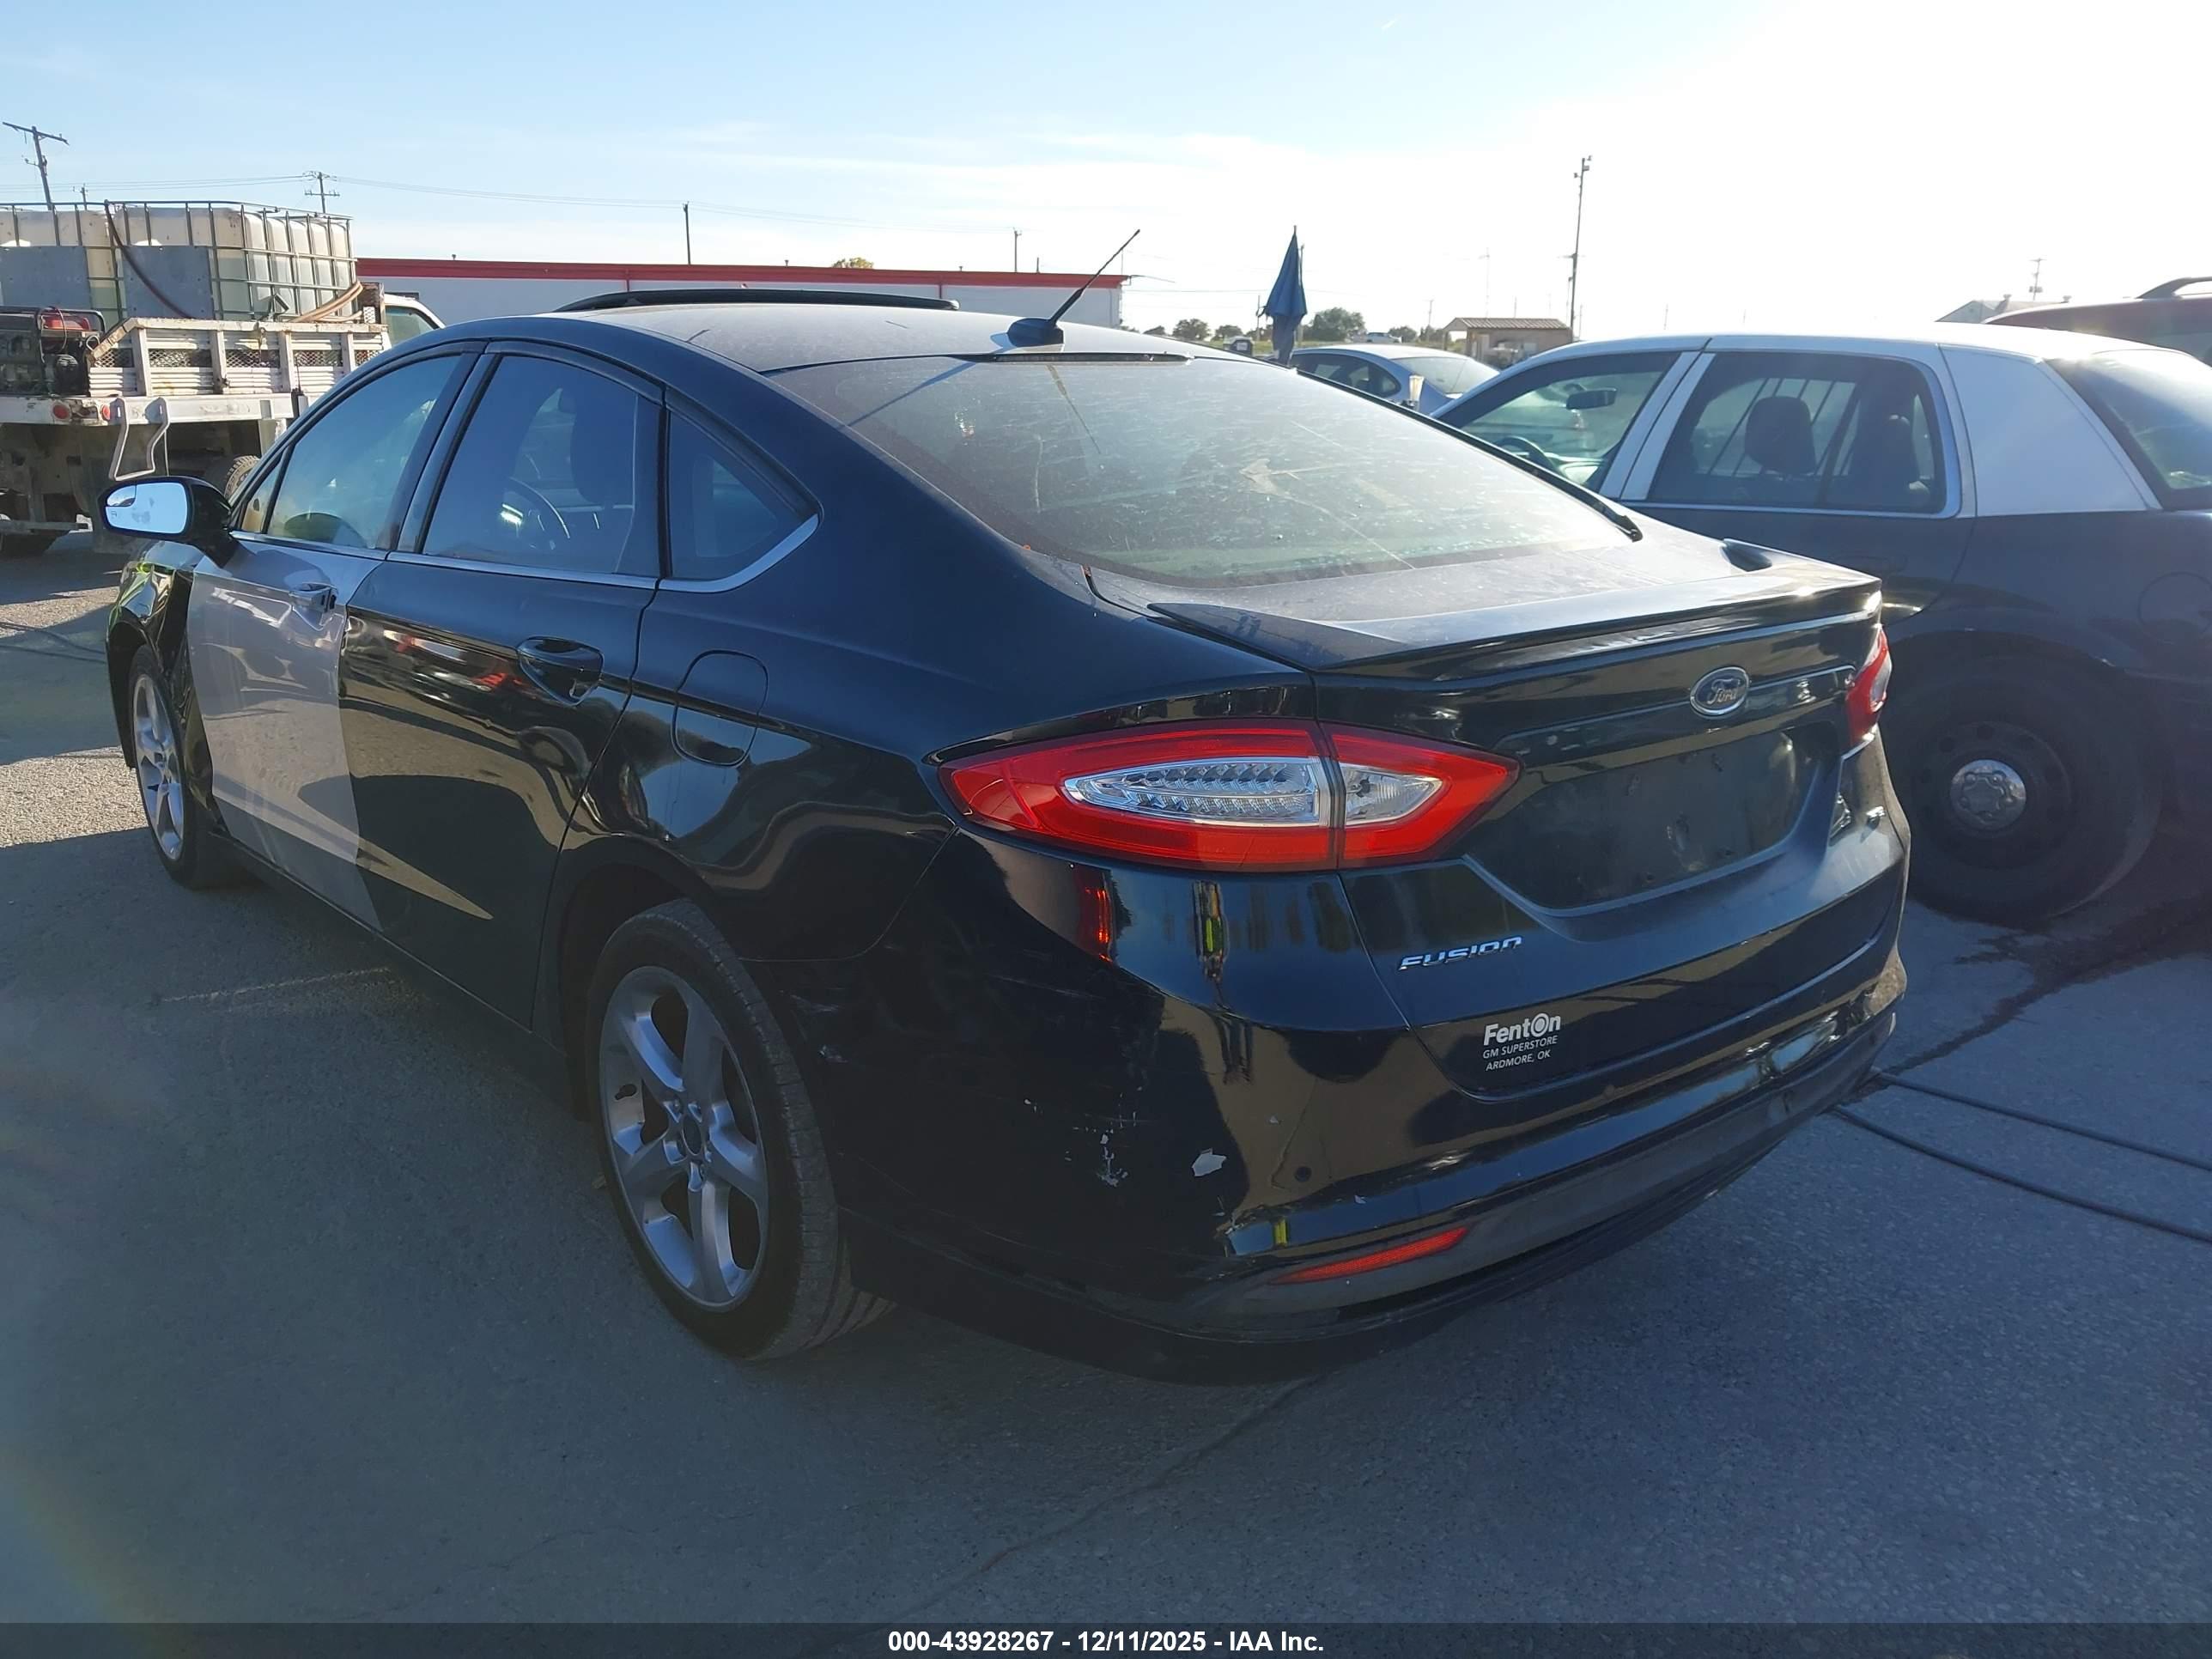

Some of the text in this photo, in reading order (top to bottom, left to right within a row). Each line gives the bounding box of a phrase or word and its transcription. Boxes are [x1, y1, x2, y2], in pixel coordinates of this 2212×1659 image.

[1706, 678, 1741, 704] Ford
[1483, 1035, 1559, 1059] GM SUPERSTORE
[1485, 1048, 1552, 1072] ARDMORE, OK
